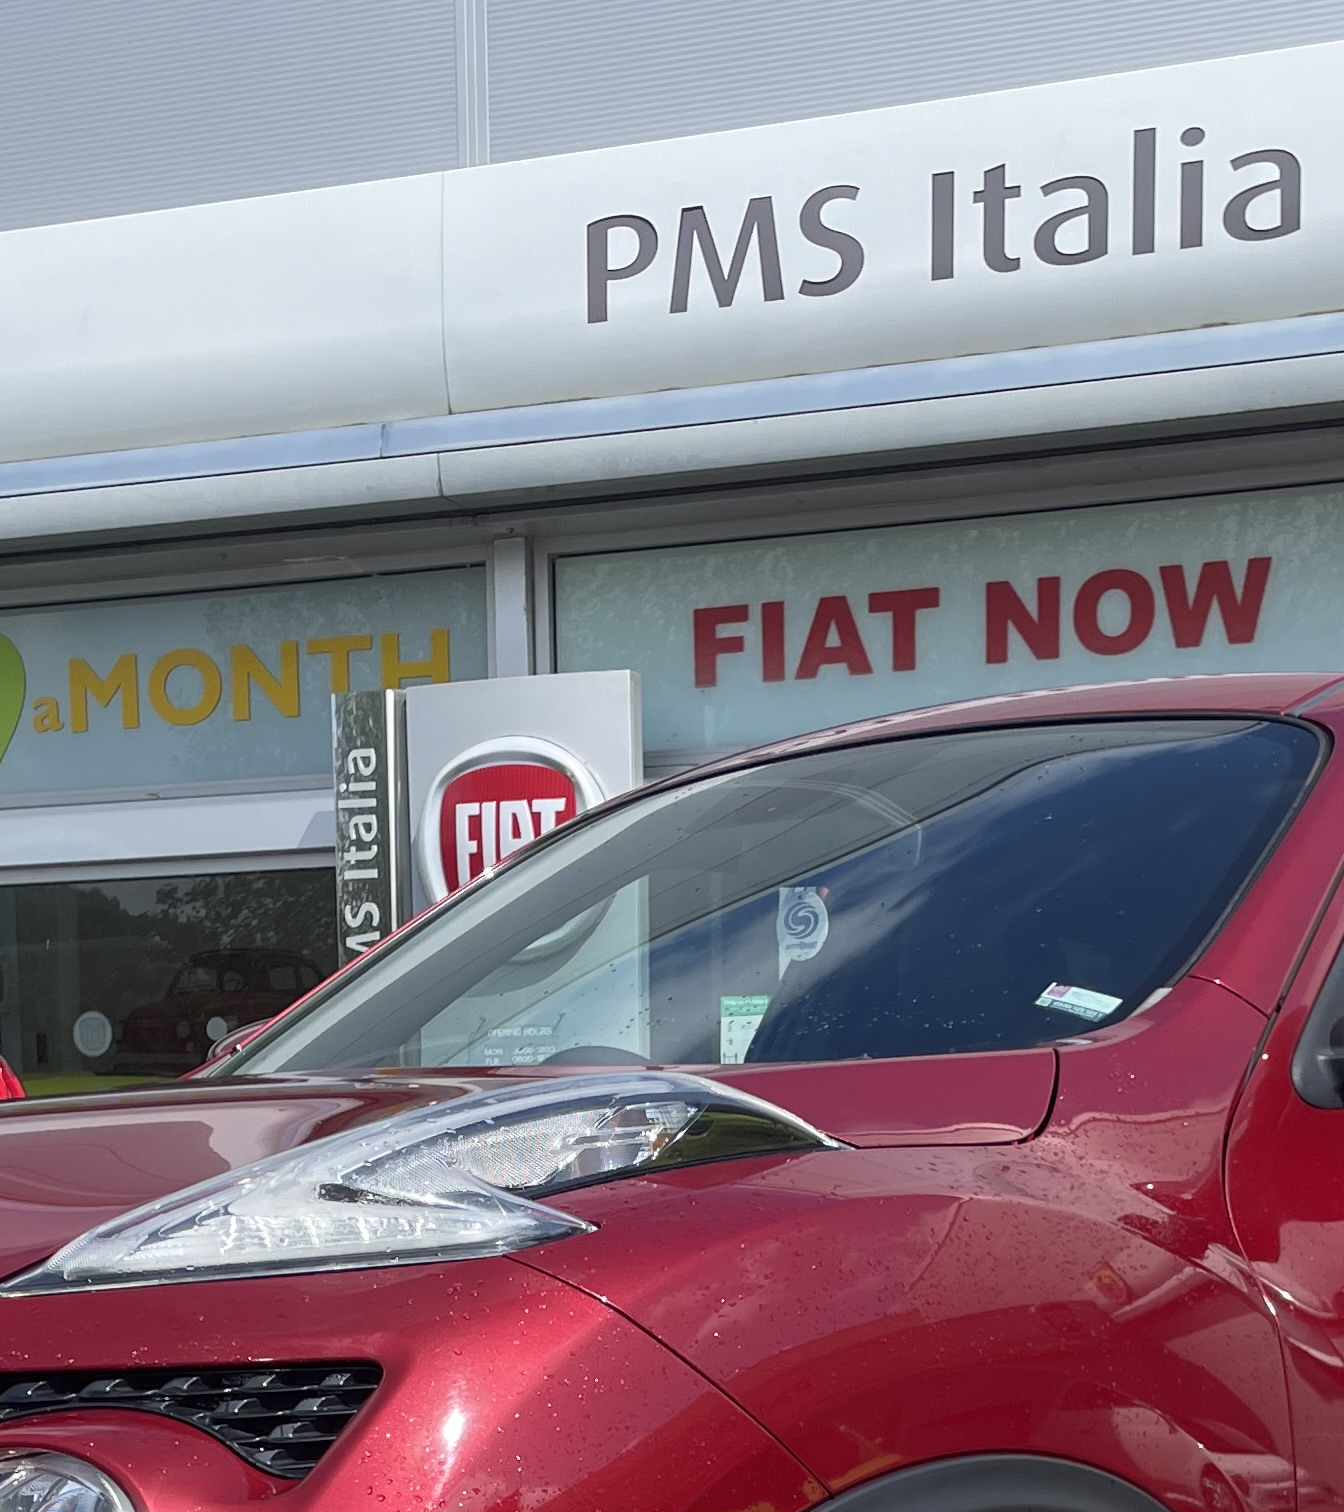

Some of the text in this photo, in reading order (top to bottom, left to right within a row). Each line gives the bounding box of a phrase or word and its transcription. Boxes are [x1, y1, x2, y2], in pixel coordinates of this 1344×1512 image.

[587, 126, 1303, 324] PMS Italia
[67, 628, 452, 734] MONTH
[692, 556, 1273, 690] FIAT NOW
[338, 748, 379, 880] Italia
[455, 797, 567, 888] FIAT
